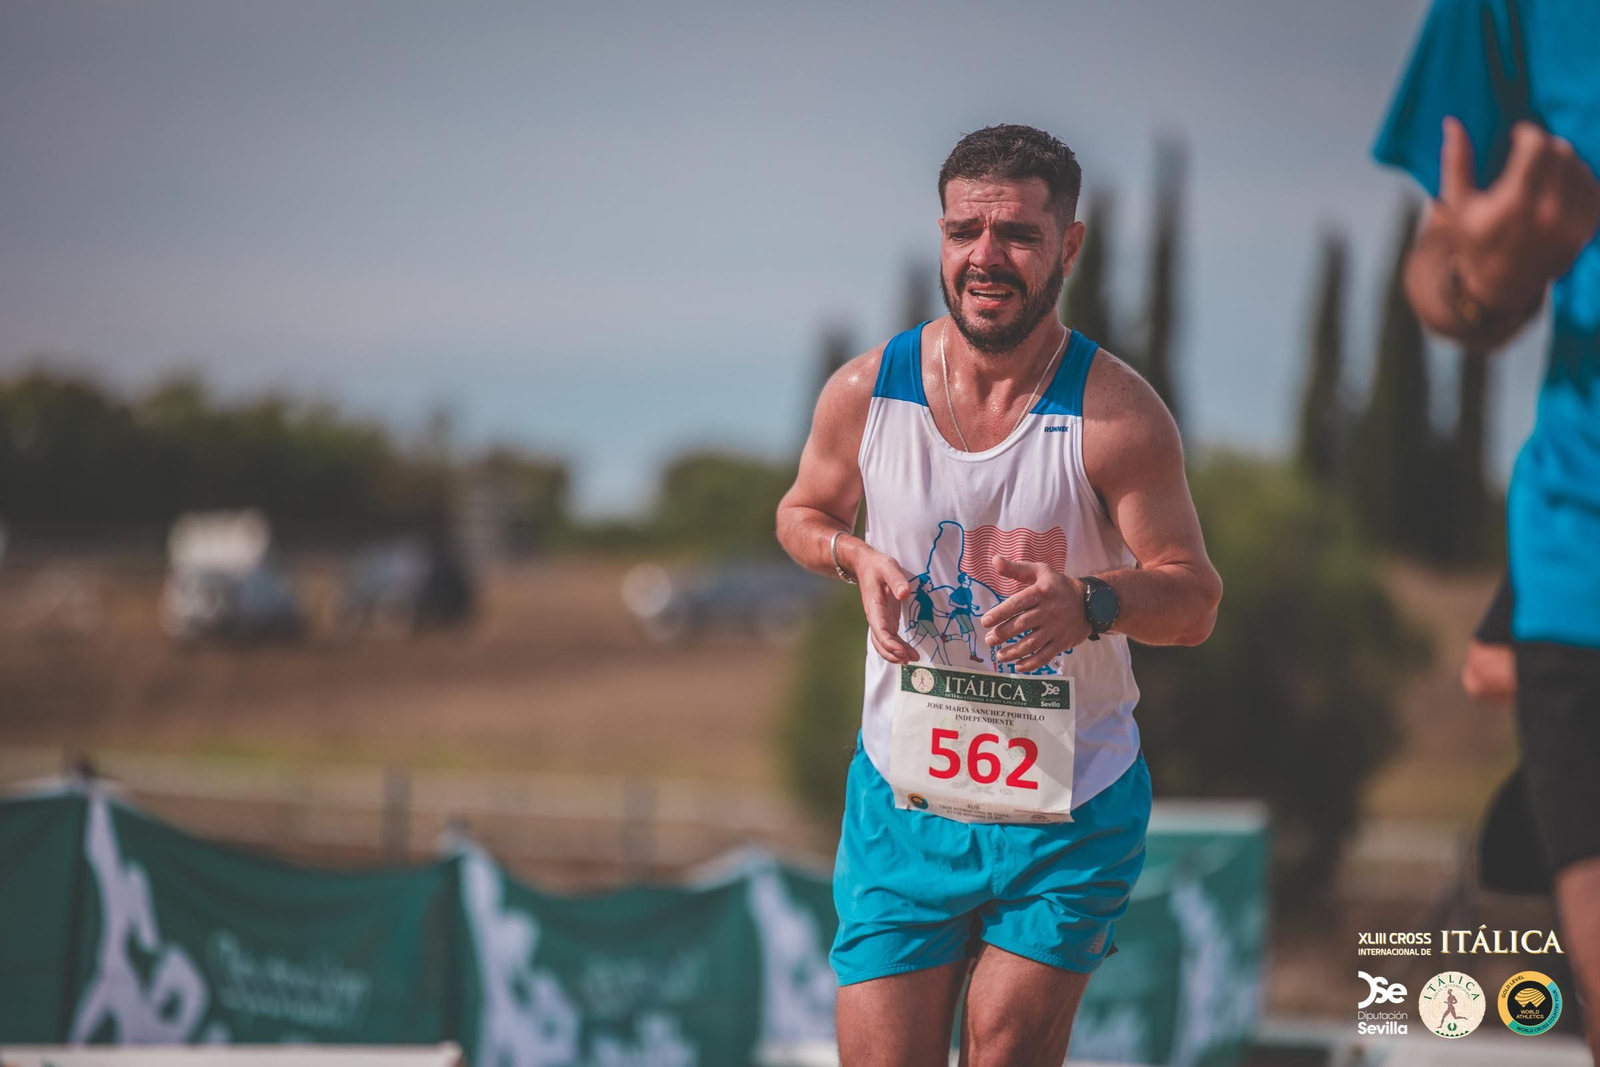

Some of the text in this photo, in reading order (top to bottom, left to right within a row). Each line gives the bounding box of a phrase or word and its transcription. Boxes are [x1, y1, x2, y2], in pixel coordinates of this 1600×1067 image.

[944, 675, 1027, 702] ITÁLICA
[927, 702, 944, 710] JOSE
[1007, 711, 1045, 722] PORTILLO
[955, 714, 1015, 727] INDEPENDIENTE
[929, 728, 1038, 790] 562
